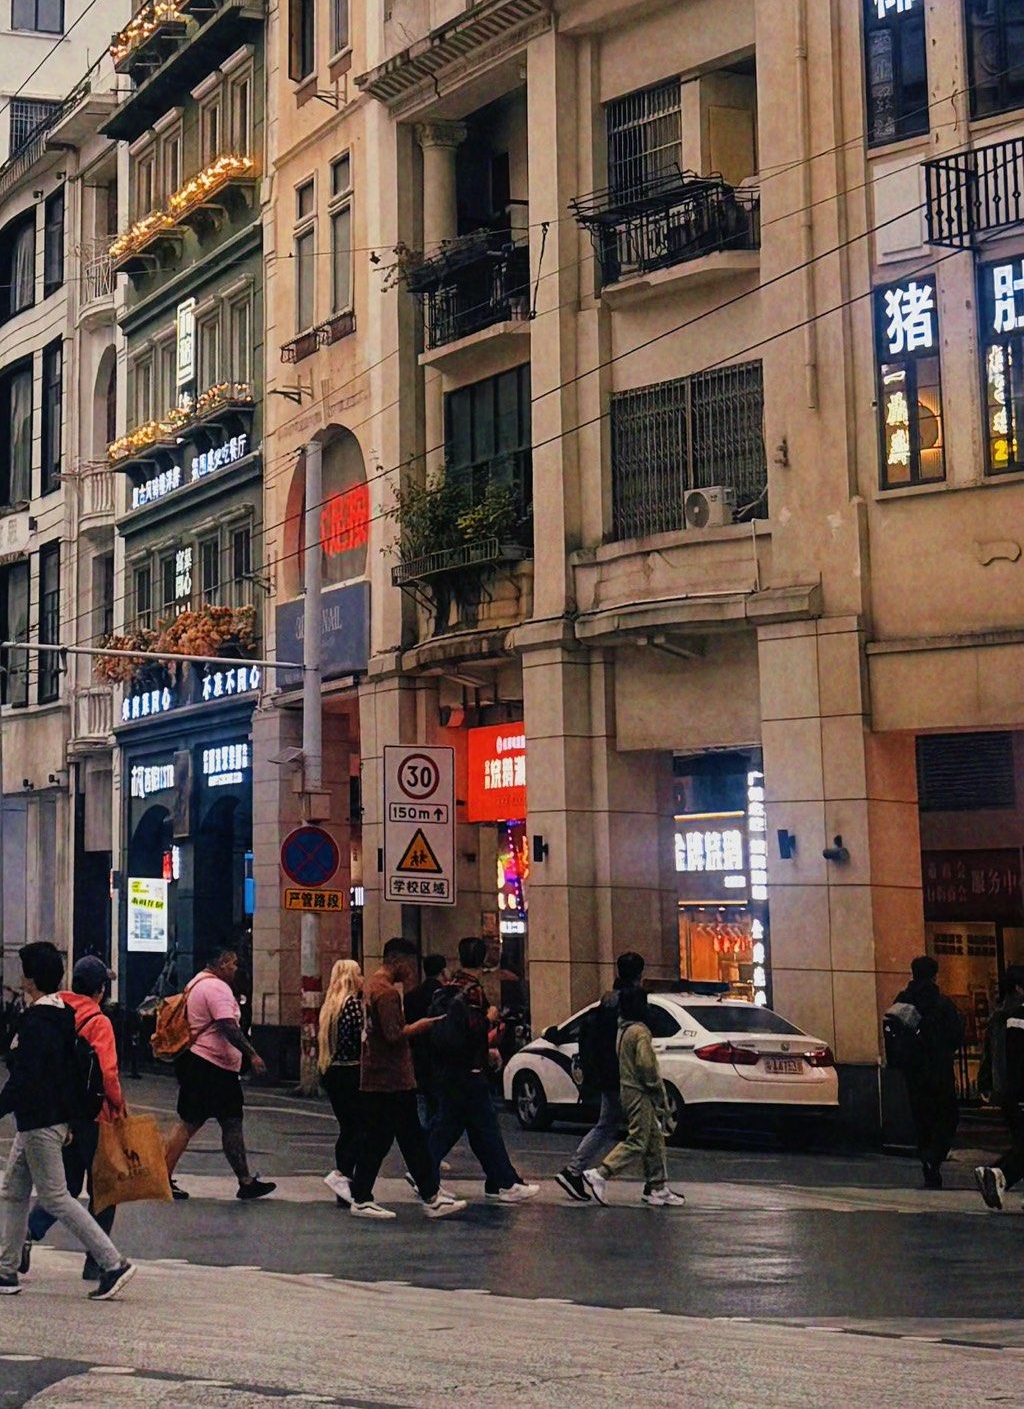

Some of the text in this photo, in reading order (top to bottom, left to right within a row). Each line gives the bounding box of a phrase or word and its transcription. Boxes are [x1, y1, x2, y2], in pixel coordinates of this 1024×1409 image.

[406, 765, 432, 788] 30
[393, 807, 430, 820] 150m
[393, 879, 445, 895] 学校区域
[288, 891, 339, 909] 严管路段
